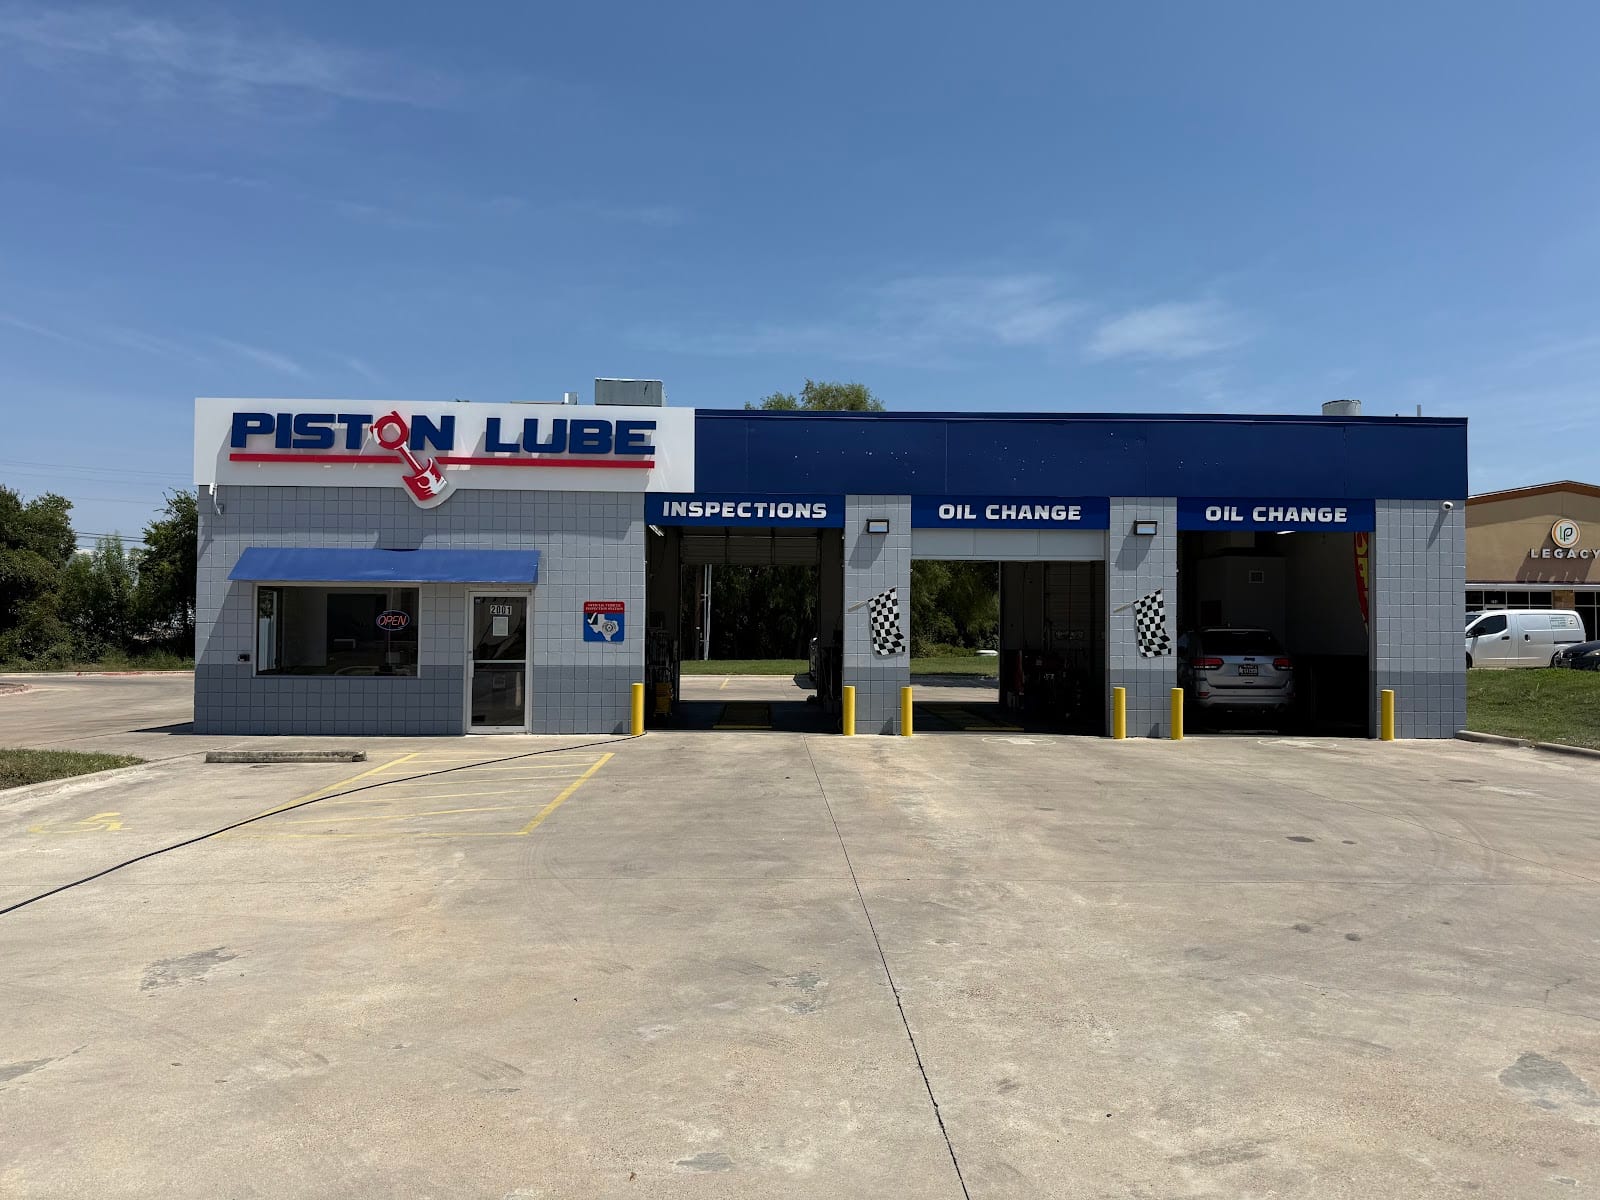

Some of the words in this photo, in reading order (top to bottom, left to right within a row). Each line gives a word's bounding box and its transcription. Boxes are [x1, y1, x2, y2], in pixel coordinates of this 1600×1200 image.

[231, 411, 455, 456] PISTON
[486, 417, 657, 456] LUBE
[662, 501, 827, 520] INSPECTIONS
[938, 504, 977, 521] OIL
[985, 505, 1081, 522] CHANGE
[1205, 506, 1244, 522] OIL
[1252, 506, 1348, 524] CHANGE
[1530, 548, 1600, 559] LEGACY
[491, 605, 511, 615] 2001
[377, 615, 407, 626] OPEN
